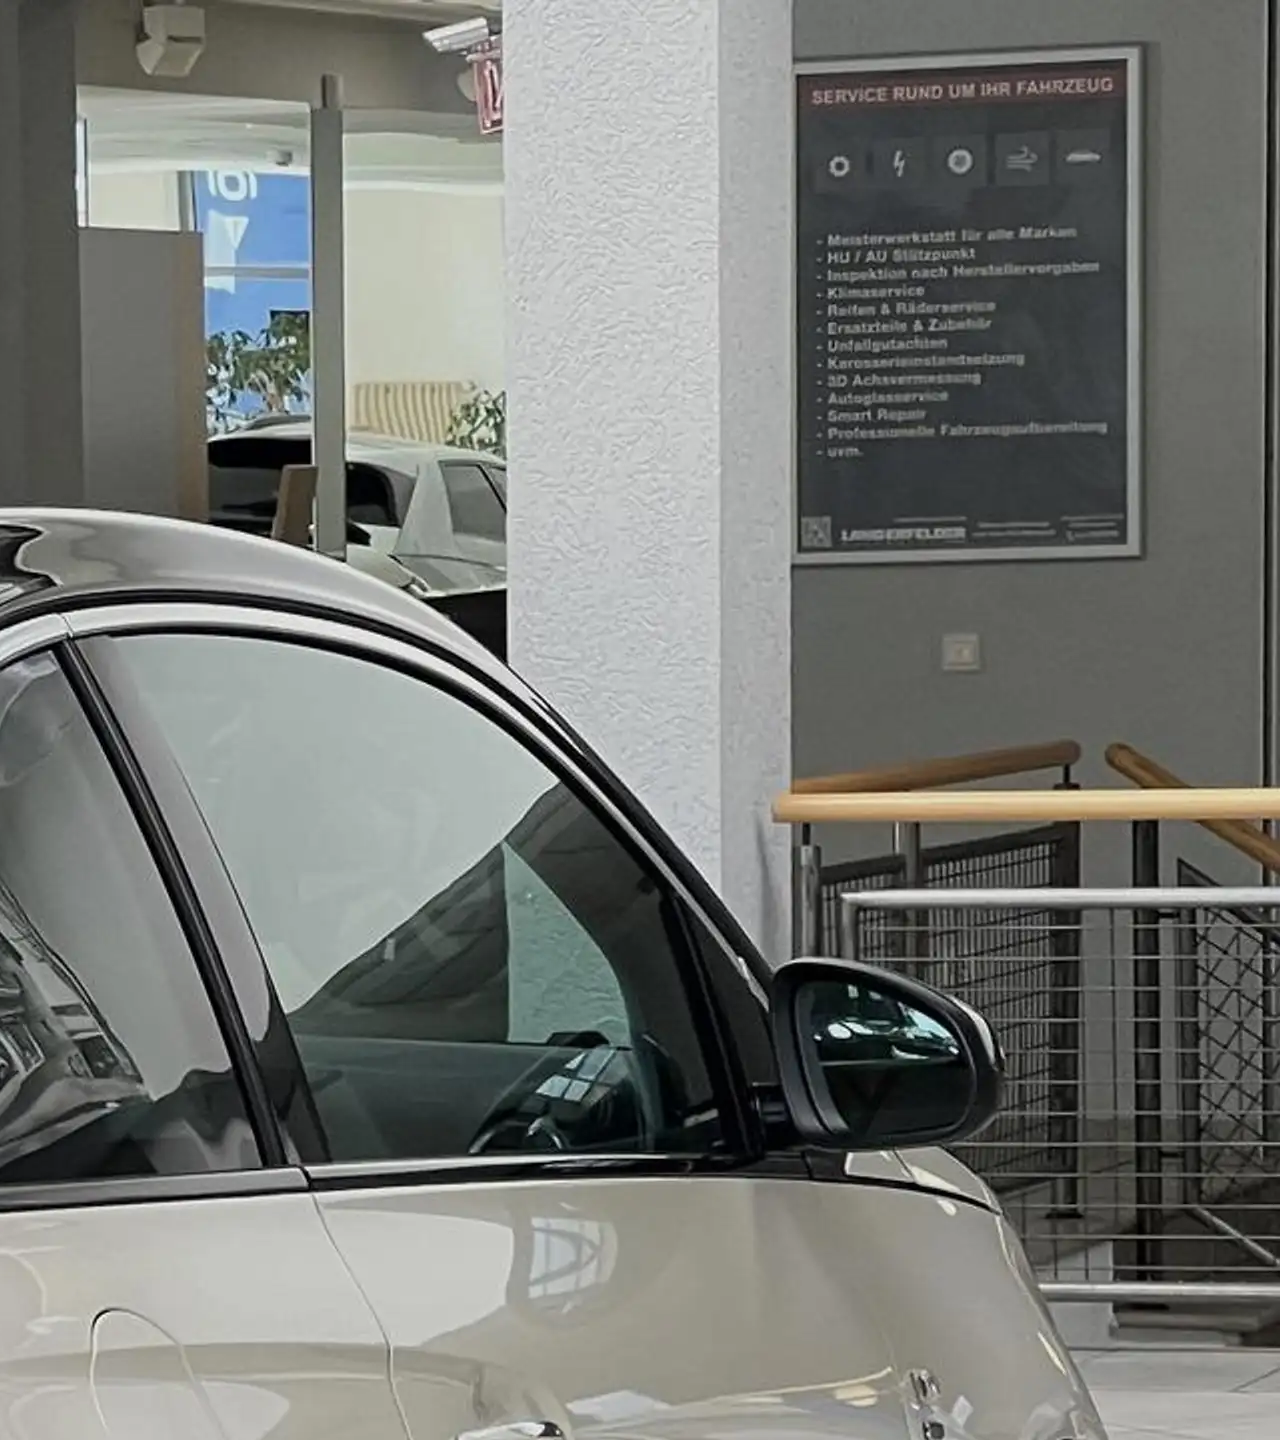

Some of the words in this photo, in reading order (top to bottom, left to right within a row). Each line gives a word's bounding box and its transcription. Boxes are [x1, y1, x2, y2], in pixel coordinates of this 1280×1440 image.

[812, 88, 888, 105] SERVICE
[893, 85, 942, 101] RUND
[948, 83, 975, 98] UM
[980, 82, 1011, 97] IHR
[1016, 77, 1114, 95] FAHRZEUG
[827, 230, 956, 247] Meisterwerkstatt
[1019, 226, 1077, 239] Marken
[827, 252, 851, 265] HU
[865, 250, 888, 263] AU
[827, 268, 907, 284] Inspektion
[911, 267, 947, 279] nach
[953, 260, 1100, 278] Herstellervorgaben
[827, 285, 925, 299] Klimaservice
[827, 304, 876, 317] Reifen
[827, 321, 907, 336] Ersatzteile
[827, 337, 948, 353] Unfallgutachten
[827, 409, 872, 422] Smart
